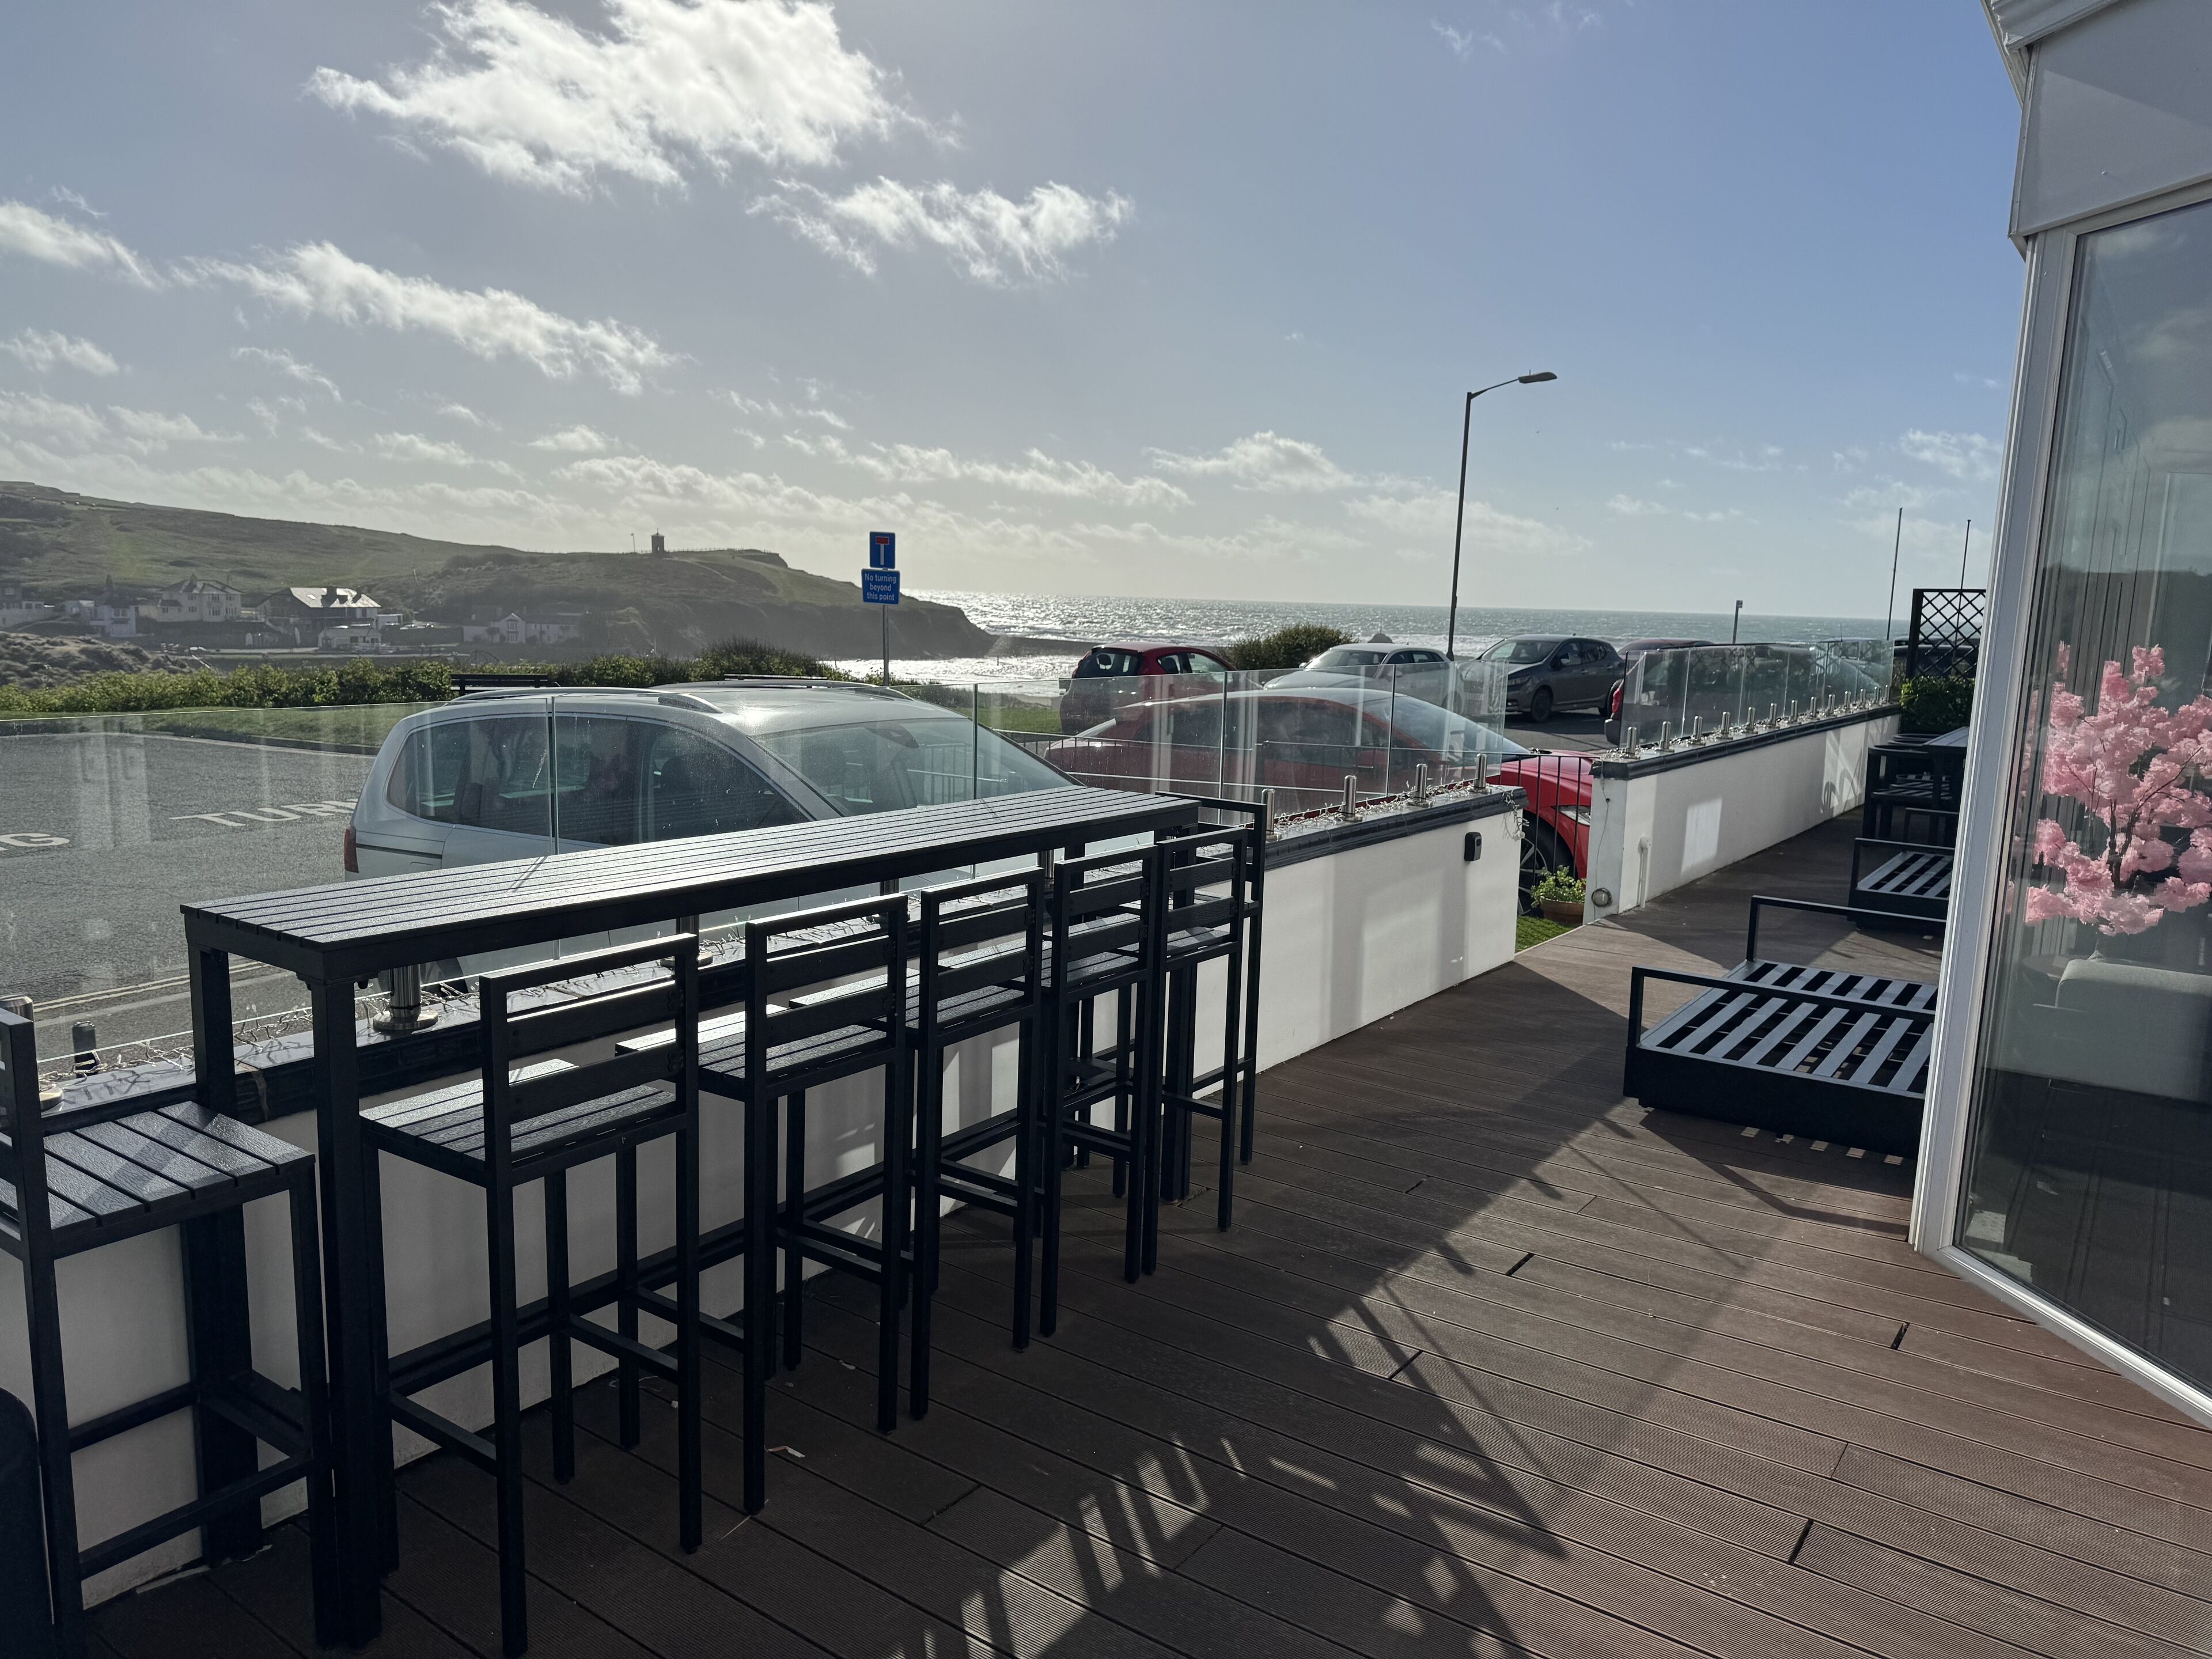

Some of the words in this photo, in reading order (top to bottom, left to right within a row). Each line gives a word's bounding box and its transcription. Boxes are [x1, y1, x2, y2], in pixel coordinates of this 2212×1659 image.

[875, 574, 896, 584] turning
[870, 582, 892, 592] beyond
[867, 591, 878, 600] this
[879, 592, 895, 601] point
